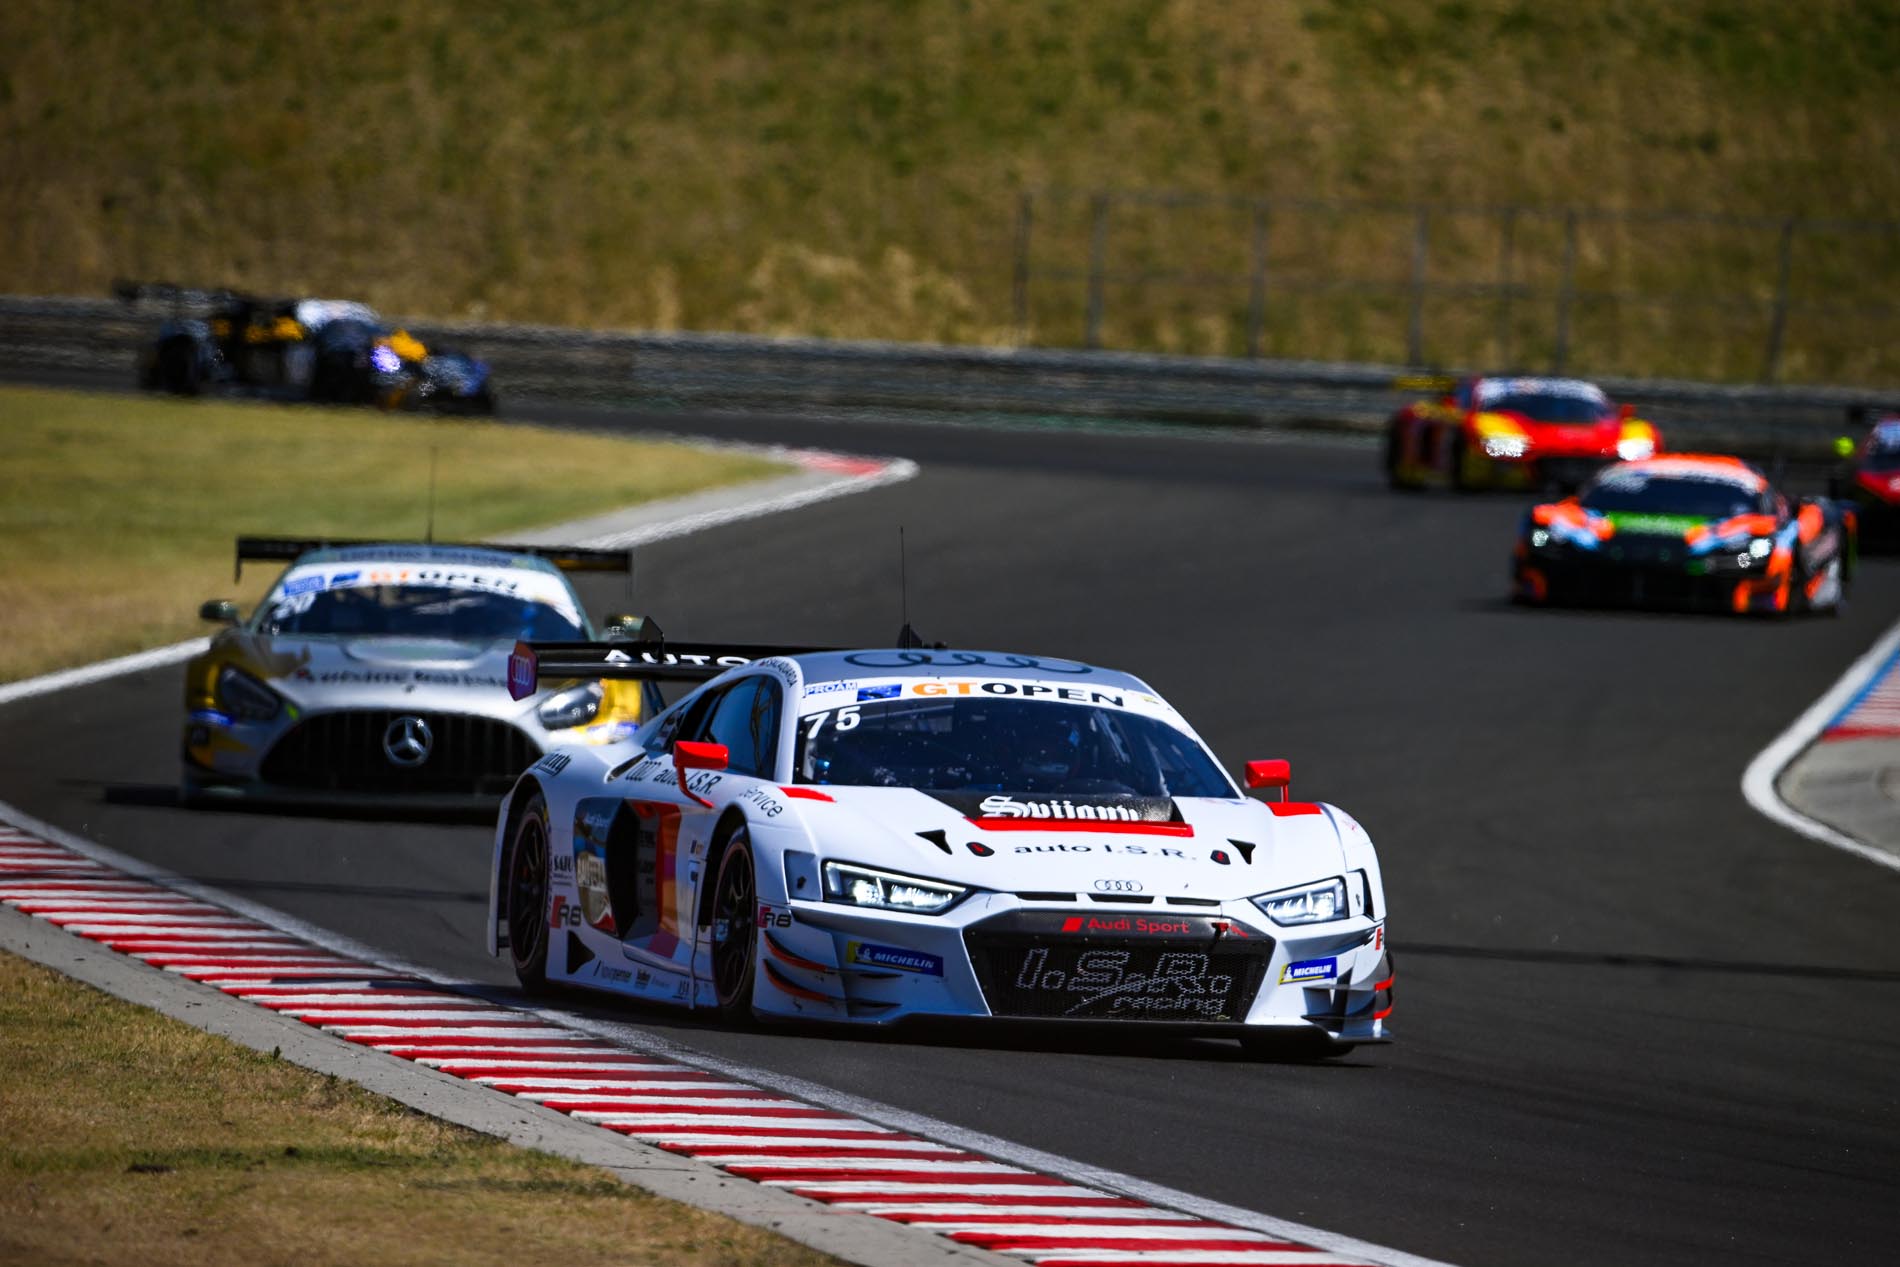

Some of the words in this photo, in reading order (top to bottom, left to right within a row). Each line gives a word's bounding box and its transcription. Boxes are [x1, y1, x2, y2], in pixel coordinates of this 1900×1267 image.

[604, 649, 752, 667] AUTO
[803, 705, 861, 740] 75
[1014, 843, 1092, 854] auto
[764, 911, 792, 928] R8
[1087, 917, 1131, 931] Audi
[1136, 919, 1190, 934] Sport
[873, 951, 935, 969] MICHELIN
[1293, 963, 1332, 977] MICHELIN
